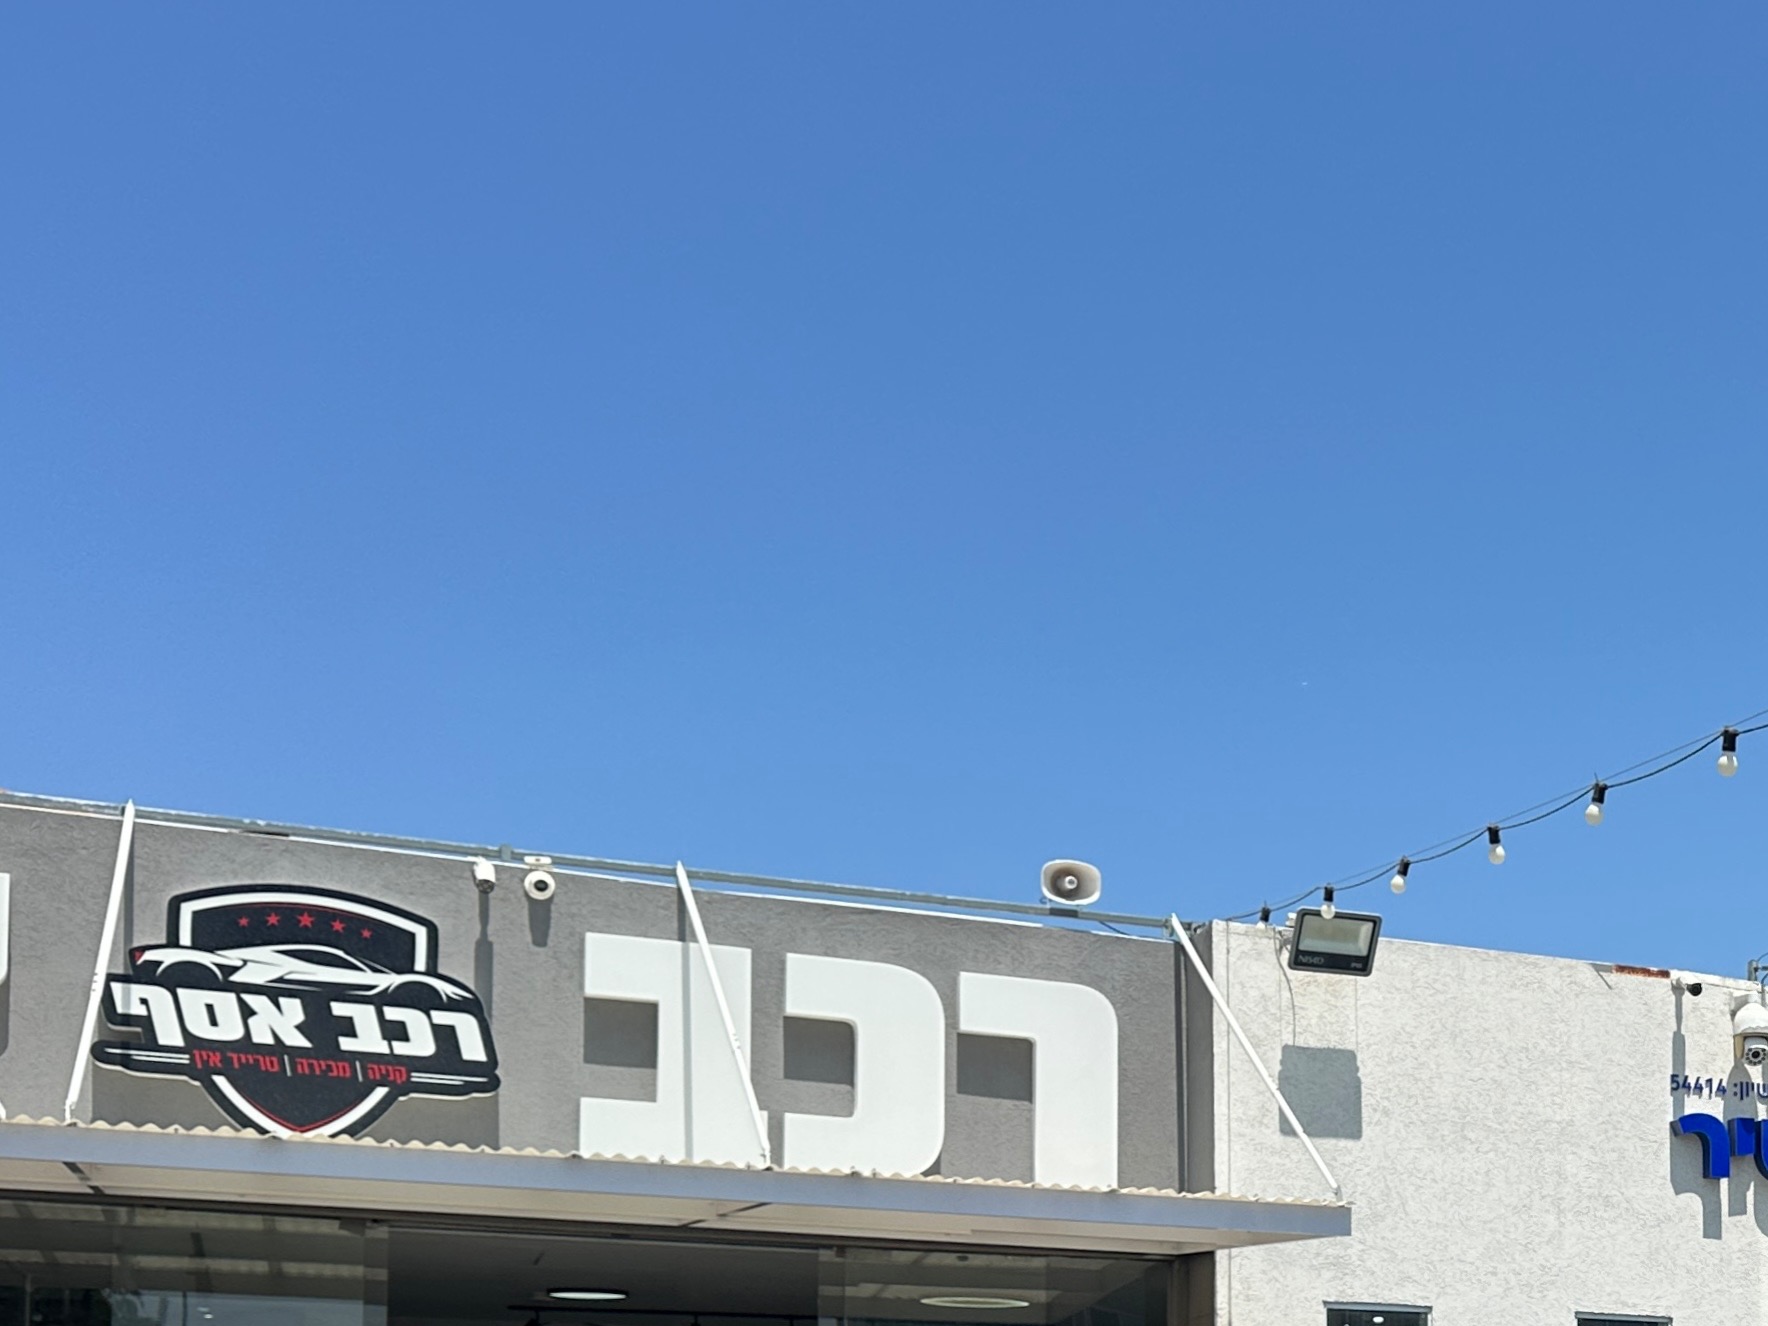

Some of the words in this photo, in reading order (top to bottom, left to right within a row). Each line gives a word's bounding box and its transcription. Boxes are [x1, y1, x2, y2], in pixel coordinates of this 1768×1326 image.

[109, 982, 312, 1048] אסף
[328, 1001, 487, 1062] רכב
[193, 1049, 222, 1069] אין
[227, 1051, 280, 1072] טרייד
[295, 1057, 352, 1077] מכירה
[578, 932, 1118, 1189] רכב
[367, 1062, 407, 1084] קניה
[1670, 1073, 1727, 1095] 54414
